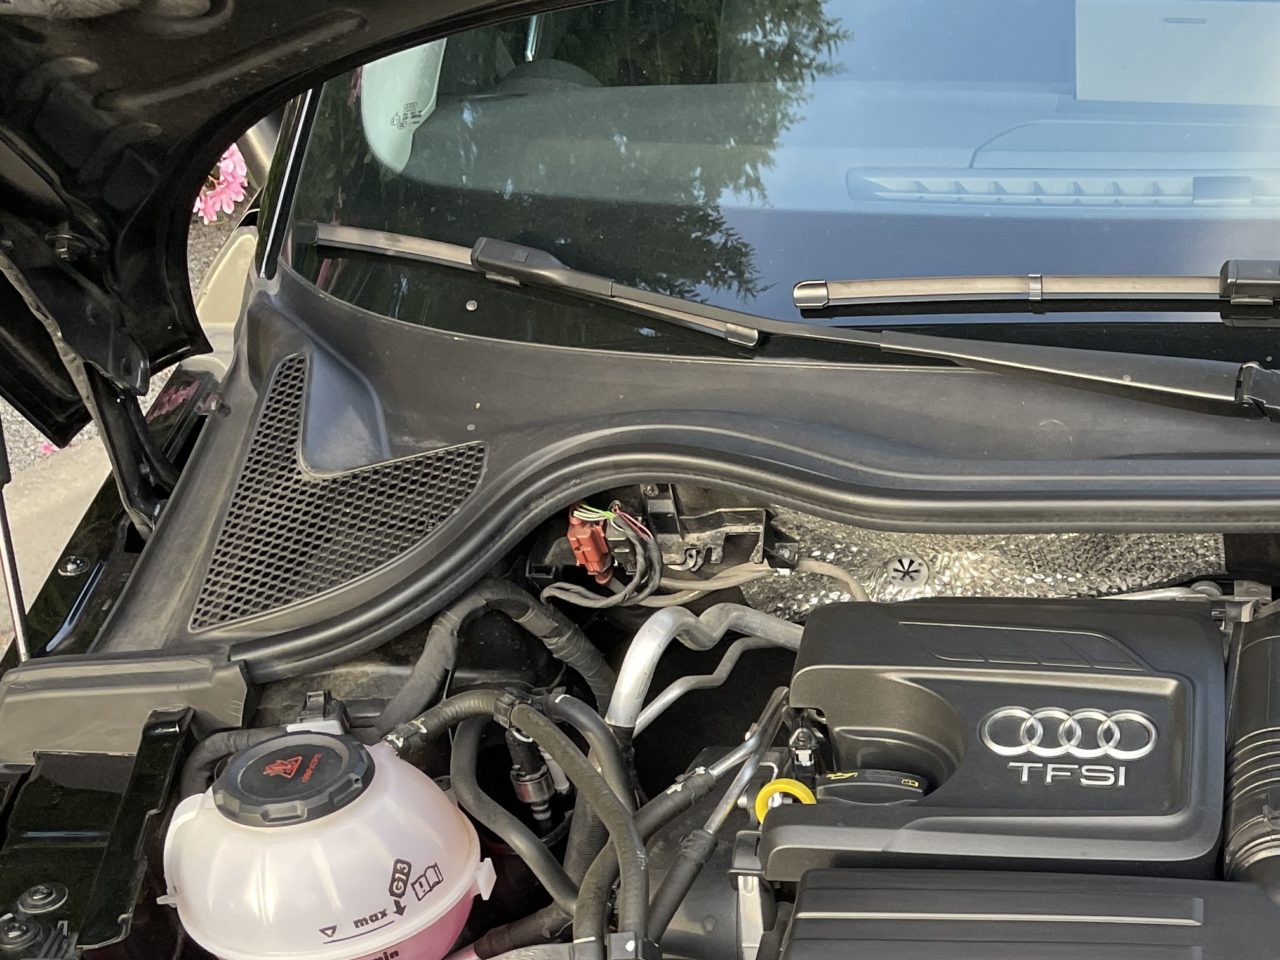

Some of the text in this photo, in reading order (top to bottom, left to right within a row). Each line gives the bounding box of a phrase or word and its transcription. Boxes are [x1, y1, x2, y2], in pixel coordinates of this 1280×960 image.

[1007, 761, 1126, 787] TFSI
[392, 862, 410, 893] G13
[353, 908, 388, 929] max
